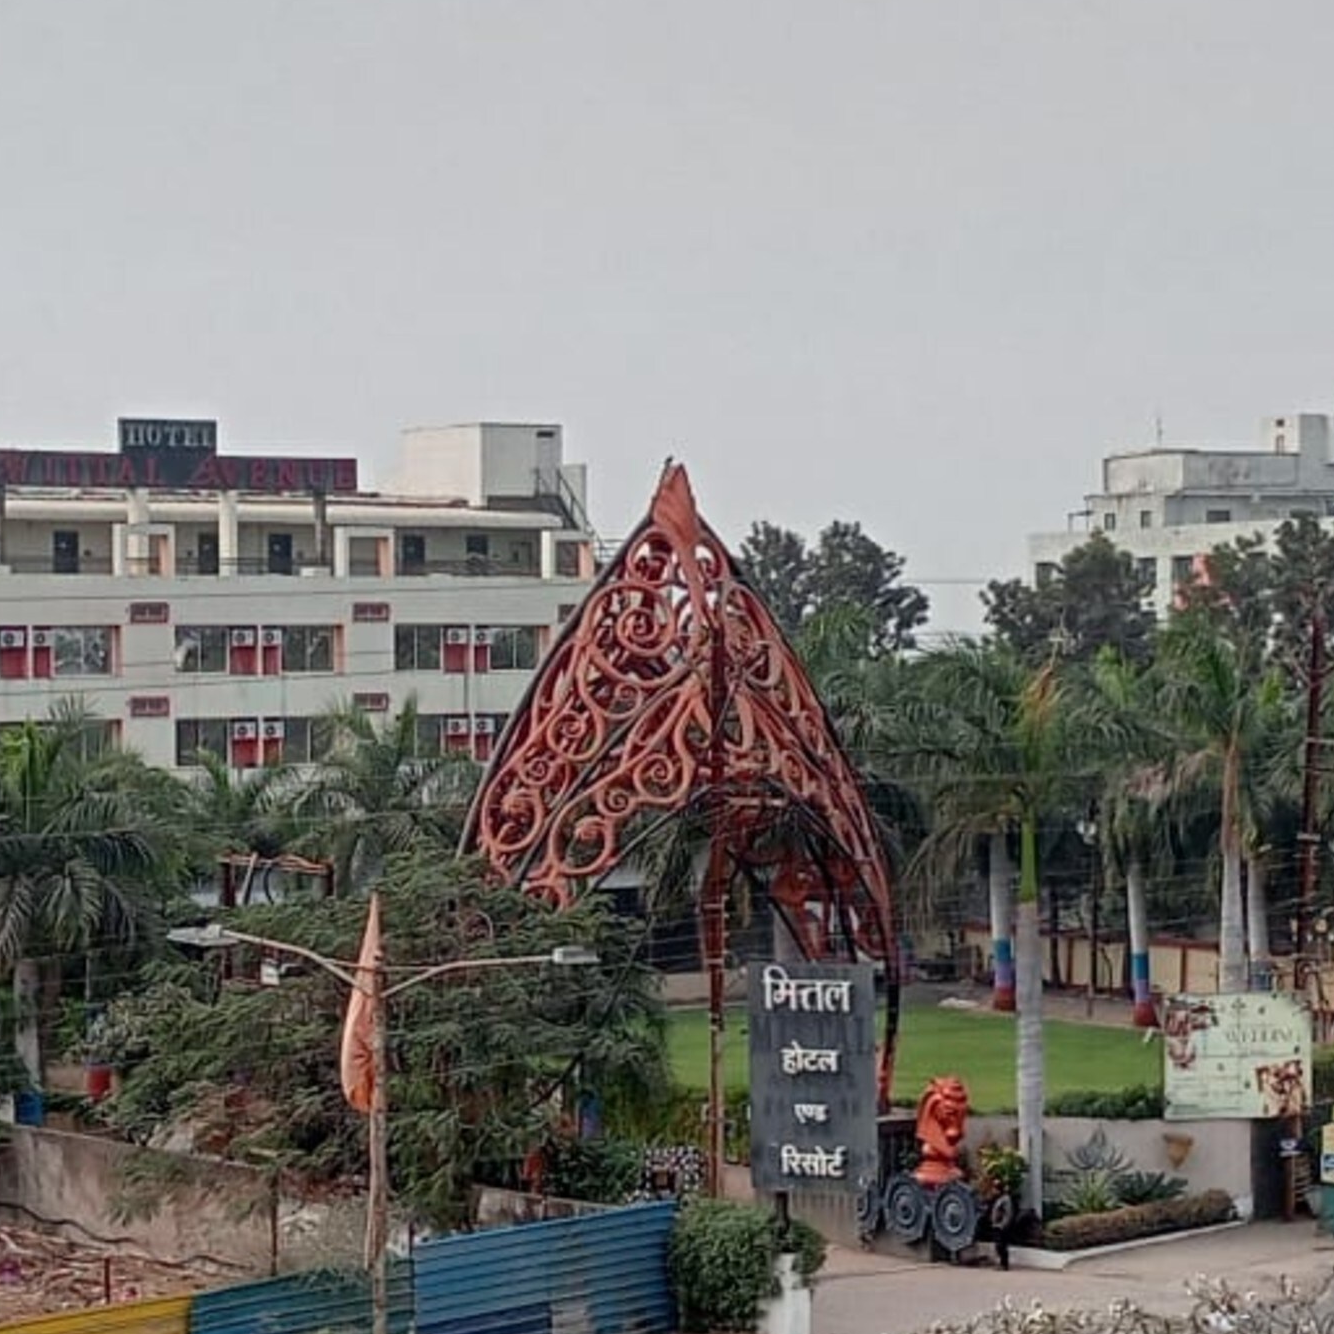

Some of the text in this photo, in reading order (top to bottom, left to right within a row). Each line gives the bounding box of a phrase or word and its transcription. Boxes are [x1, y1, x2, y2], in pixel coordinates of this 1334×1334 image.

[124, 422, 213, 448] HOTEL
[188, 454, 356, 491] AVENUE
[762, 965, 852, 1012] मित्तल
[780, 1040, 840, 1074] होटल
[780, 1144, 846, 1177] रिसोर्ट
